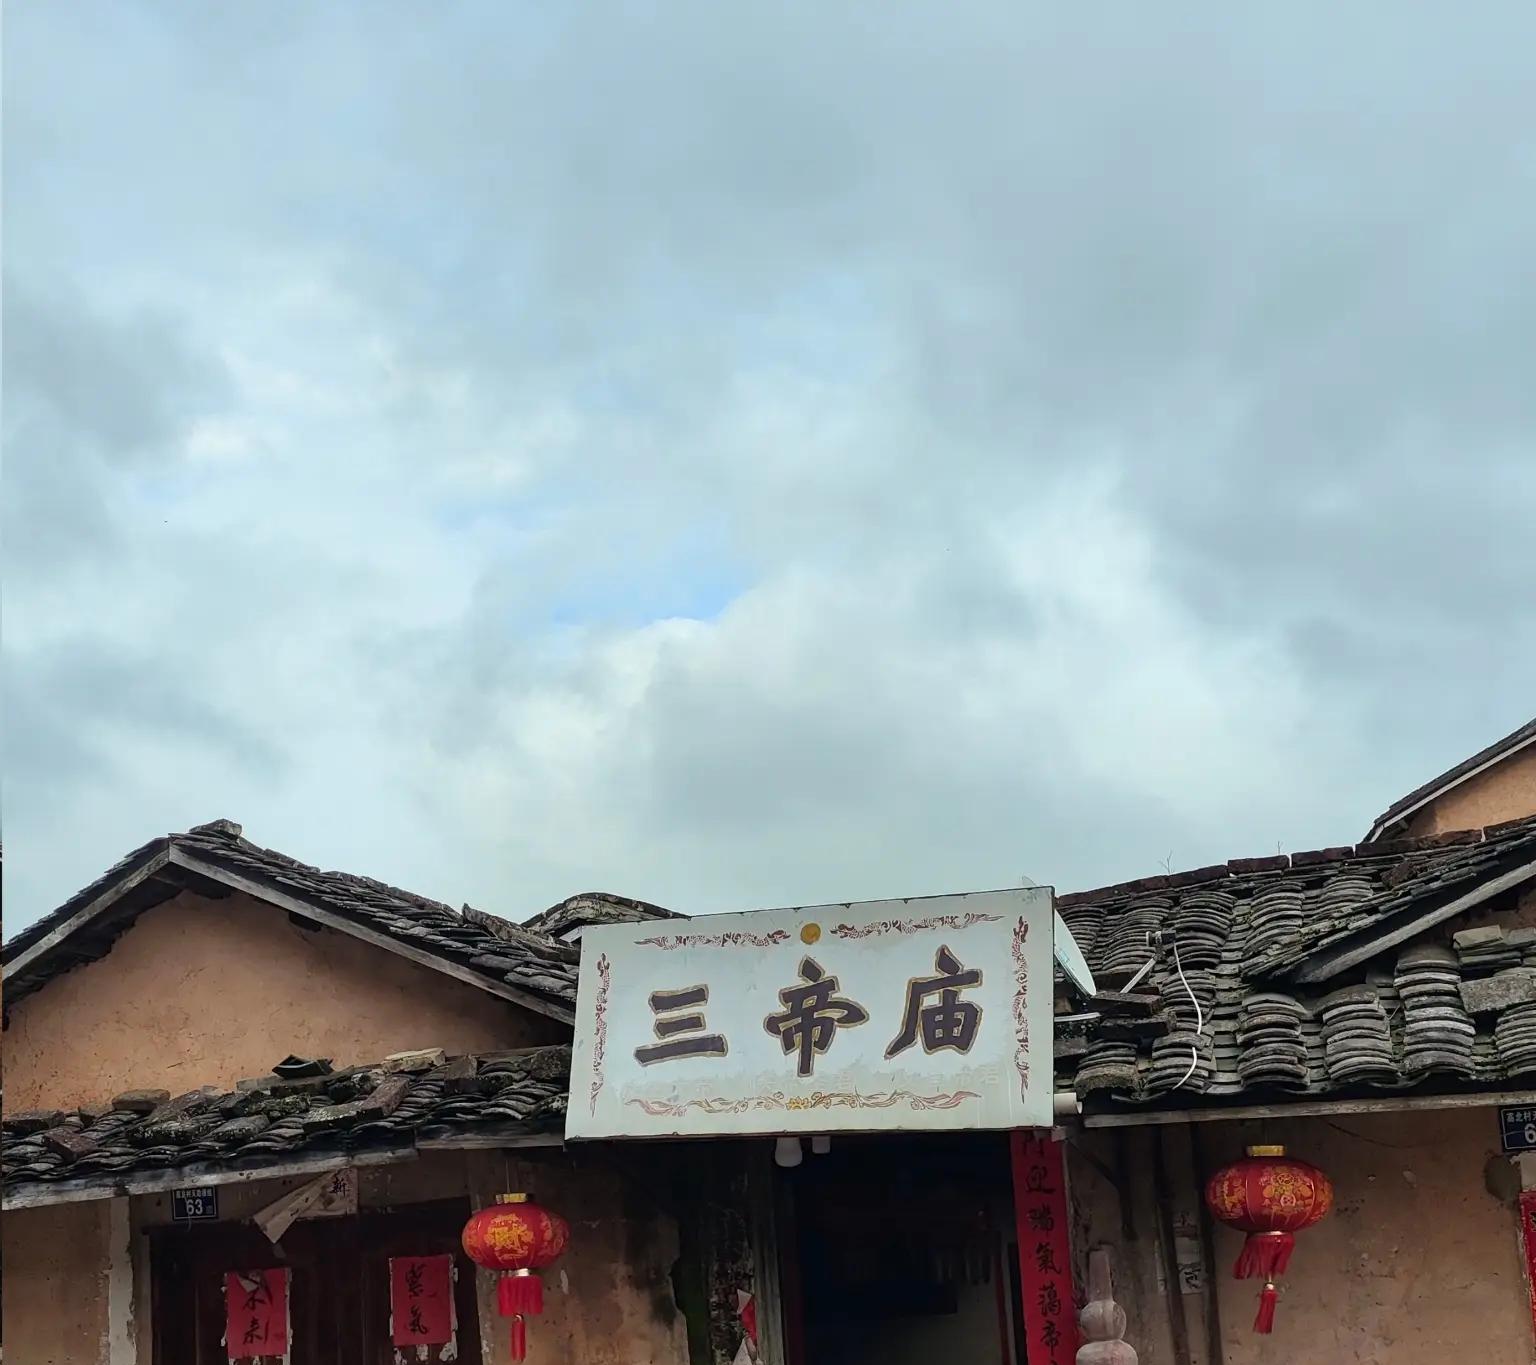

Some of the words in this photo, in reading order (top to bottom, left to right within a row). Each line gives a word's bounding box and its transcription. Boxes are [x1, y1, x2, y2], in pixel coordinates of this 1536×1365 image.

[634, 944, 983, 1077] 三帝庙
[185, 1199, 204, 1216] 63
